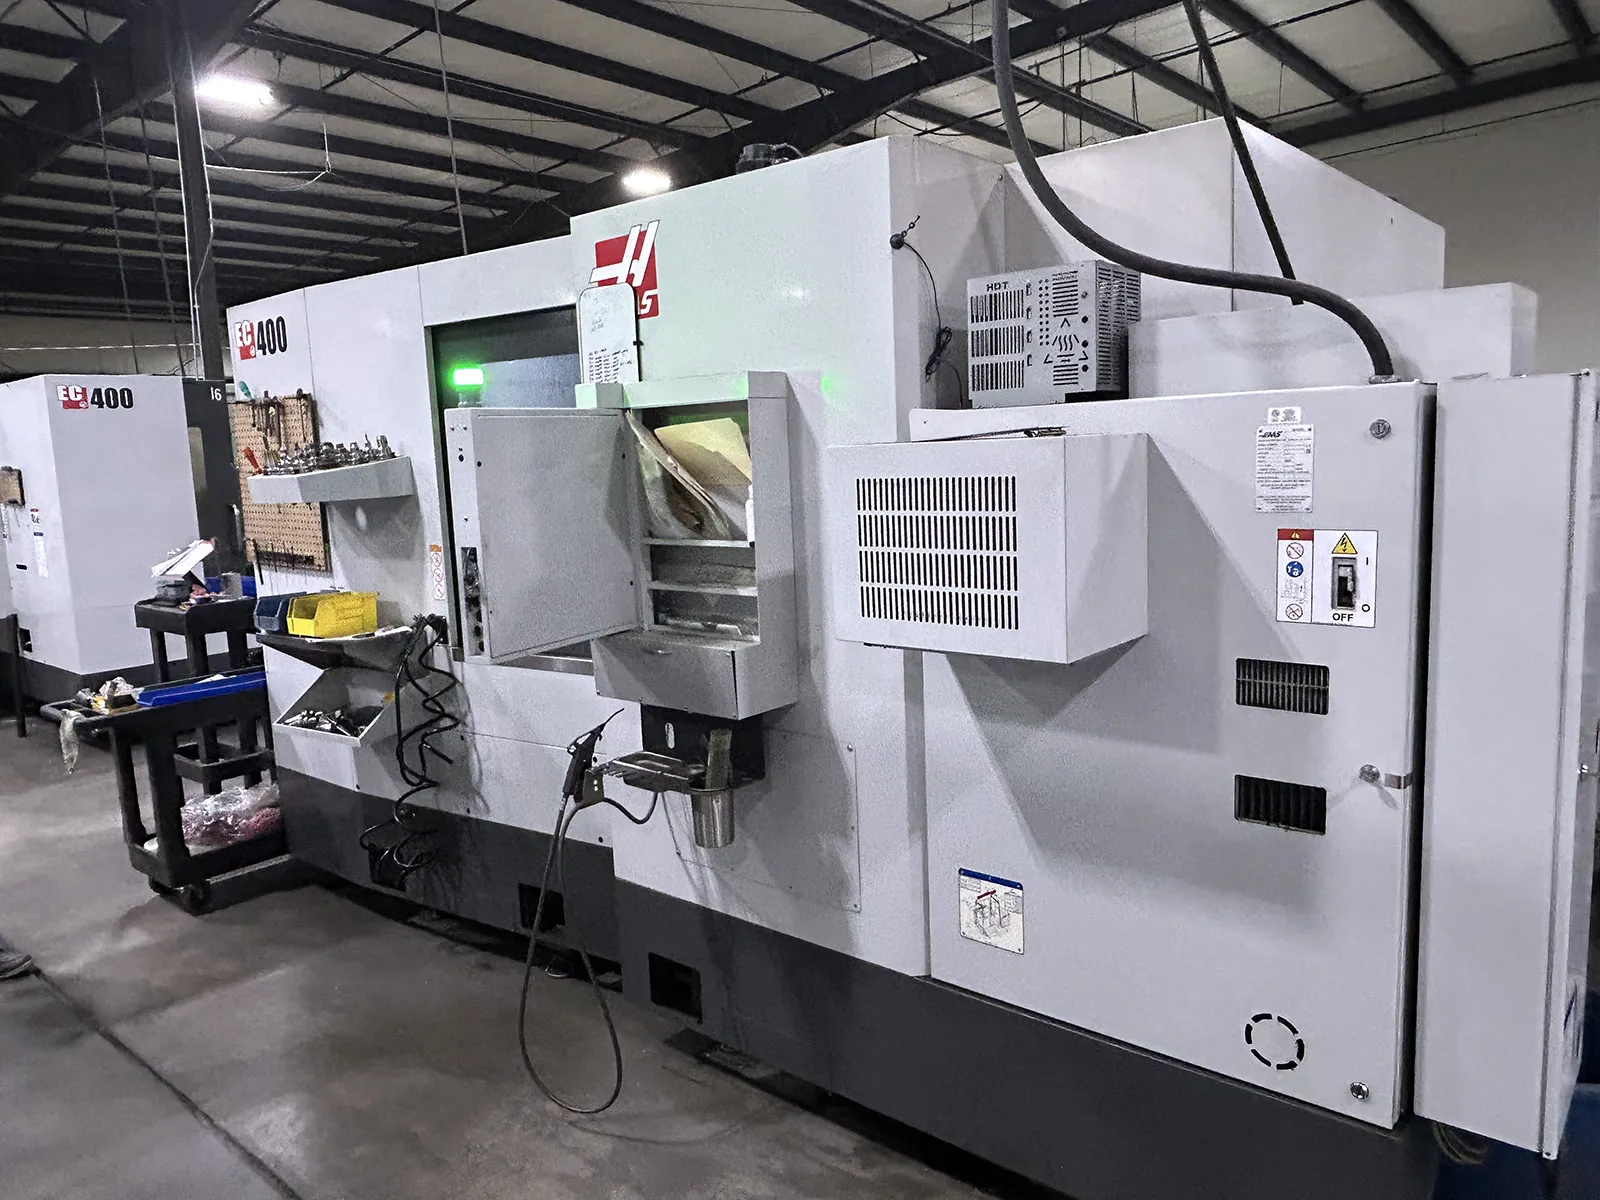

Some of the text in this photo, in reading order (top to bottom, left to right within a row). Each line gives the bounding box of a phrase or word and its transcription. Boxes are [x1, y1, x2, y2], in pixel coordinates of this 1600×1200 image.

[257, 316, 288, 355] 400
[56, 384, 134, 409] EC 400
[210, 386, 221, 400] 16
[1332, 613, 1354, 622] OFF
